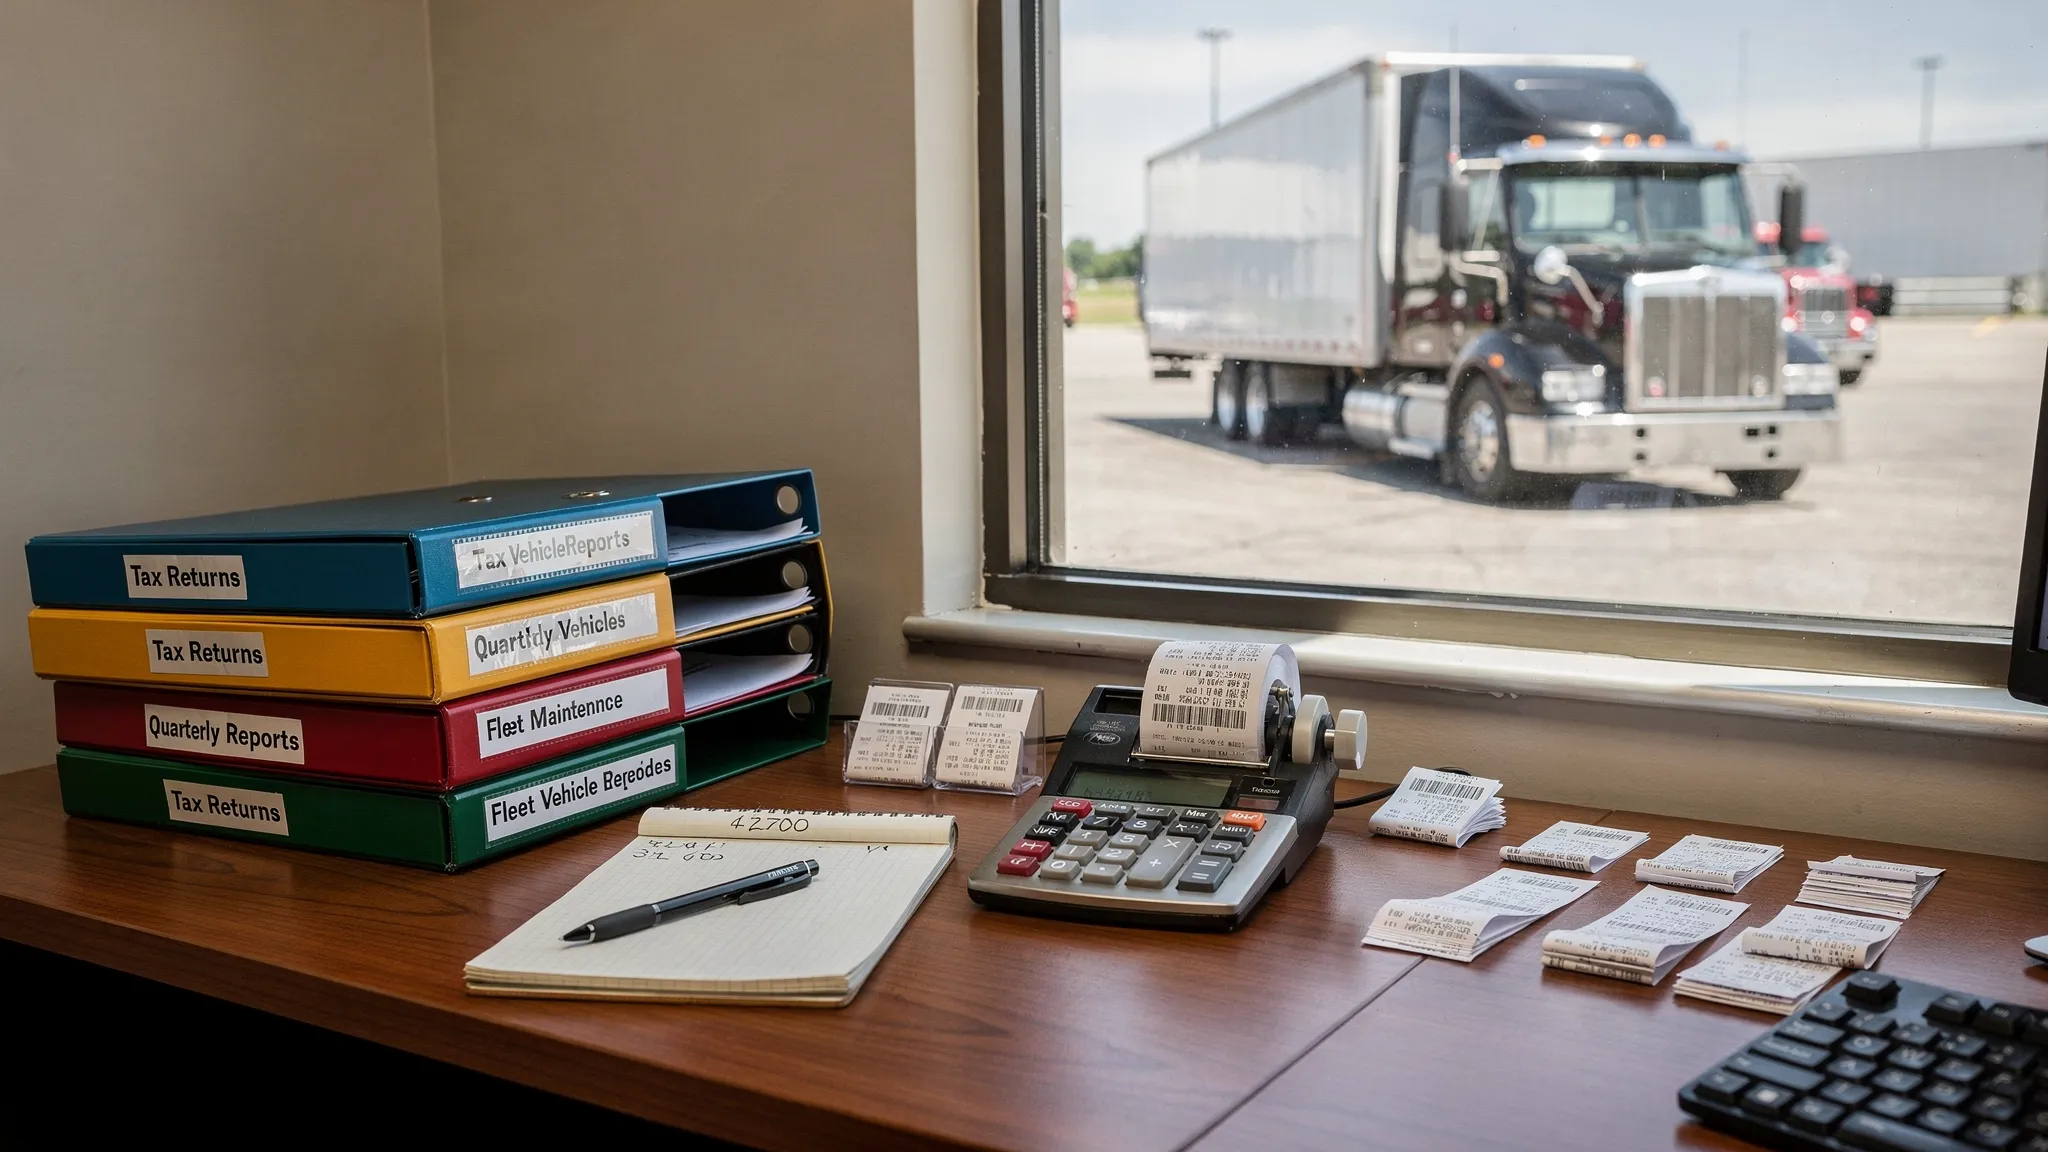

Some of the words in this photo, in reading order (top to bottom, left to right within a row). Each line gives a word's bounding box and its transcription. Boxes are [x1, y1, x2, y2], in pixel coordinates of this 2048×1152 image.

[472, 547, 507, 570] Tax
[130, 564, 163, 588] Tax
[167, 565, 241, 588] Returns
[557, 610, 626, 640] Vehicles
[152, 639, 185, 662] Tax
[189, 640, 264, 664] Returns
[529, 693, 624, 731] Maintennce
[149, 714, 220, 747] Quarterly
[226, 722, 300, 751] Reports
[171, 789, 204, 814] Tax
[208, 794, 281, 823] Returns
[490, 797, 536, 827] Fleet
[540, 776, 598, 811] Vehicle
[730, 814, 810, 832] 42700
[1119, 834, 1136, 843] 5
[1105, 848, 1122, 858] 2
